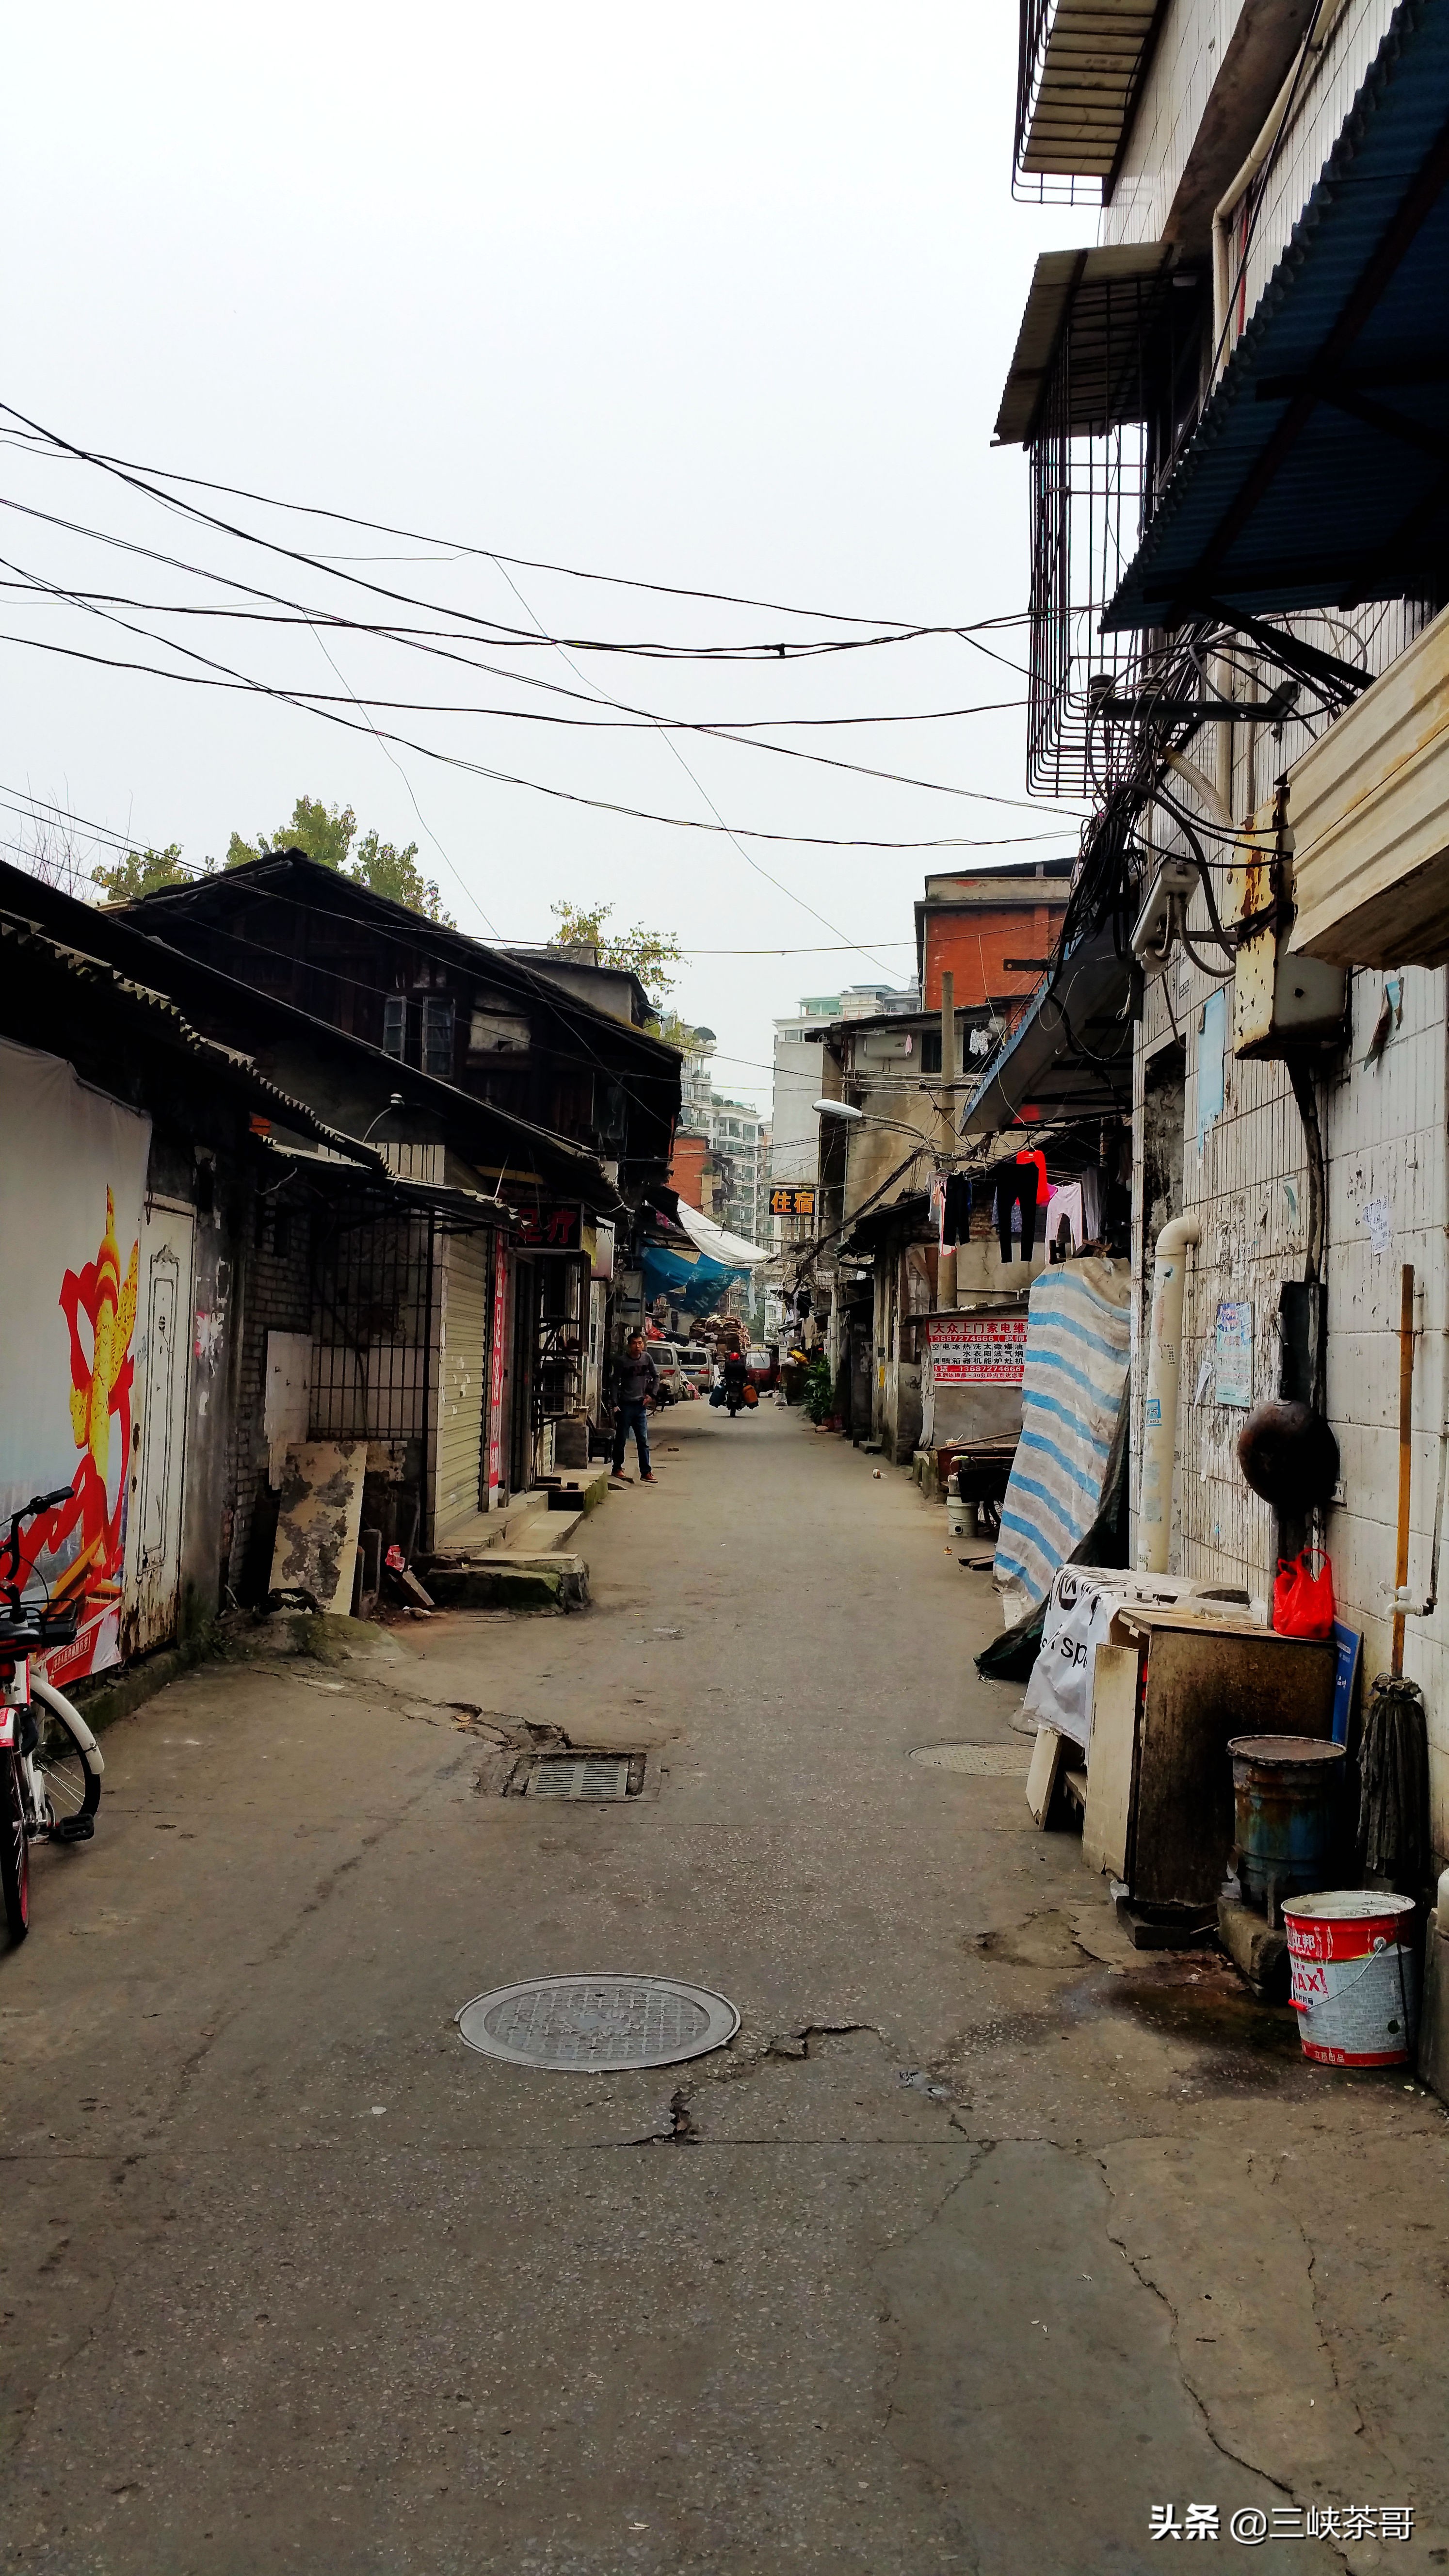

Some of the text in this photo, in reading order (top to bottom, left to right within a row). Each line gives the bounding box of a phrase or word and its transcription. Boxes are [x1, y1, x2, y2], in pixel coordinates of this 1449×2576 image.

[771, 1191, 814, 1213] 住宿
[516, 1208, 578, 1244] 足疗
[934, 1322, 1028, 1334] 大众上门家电维
